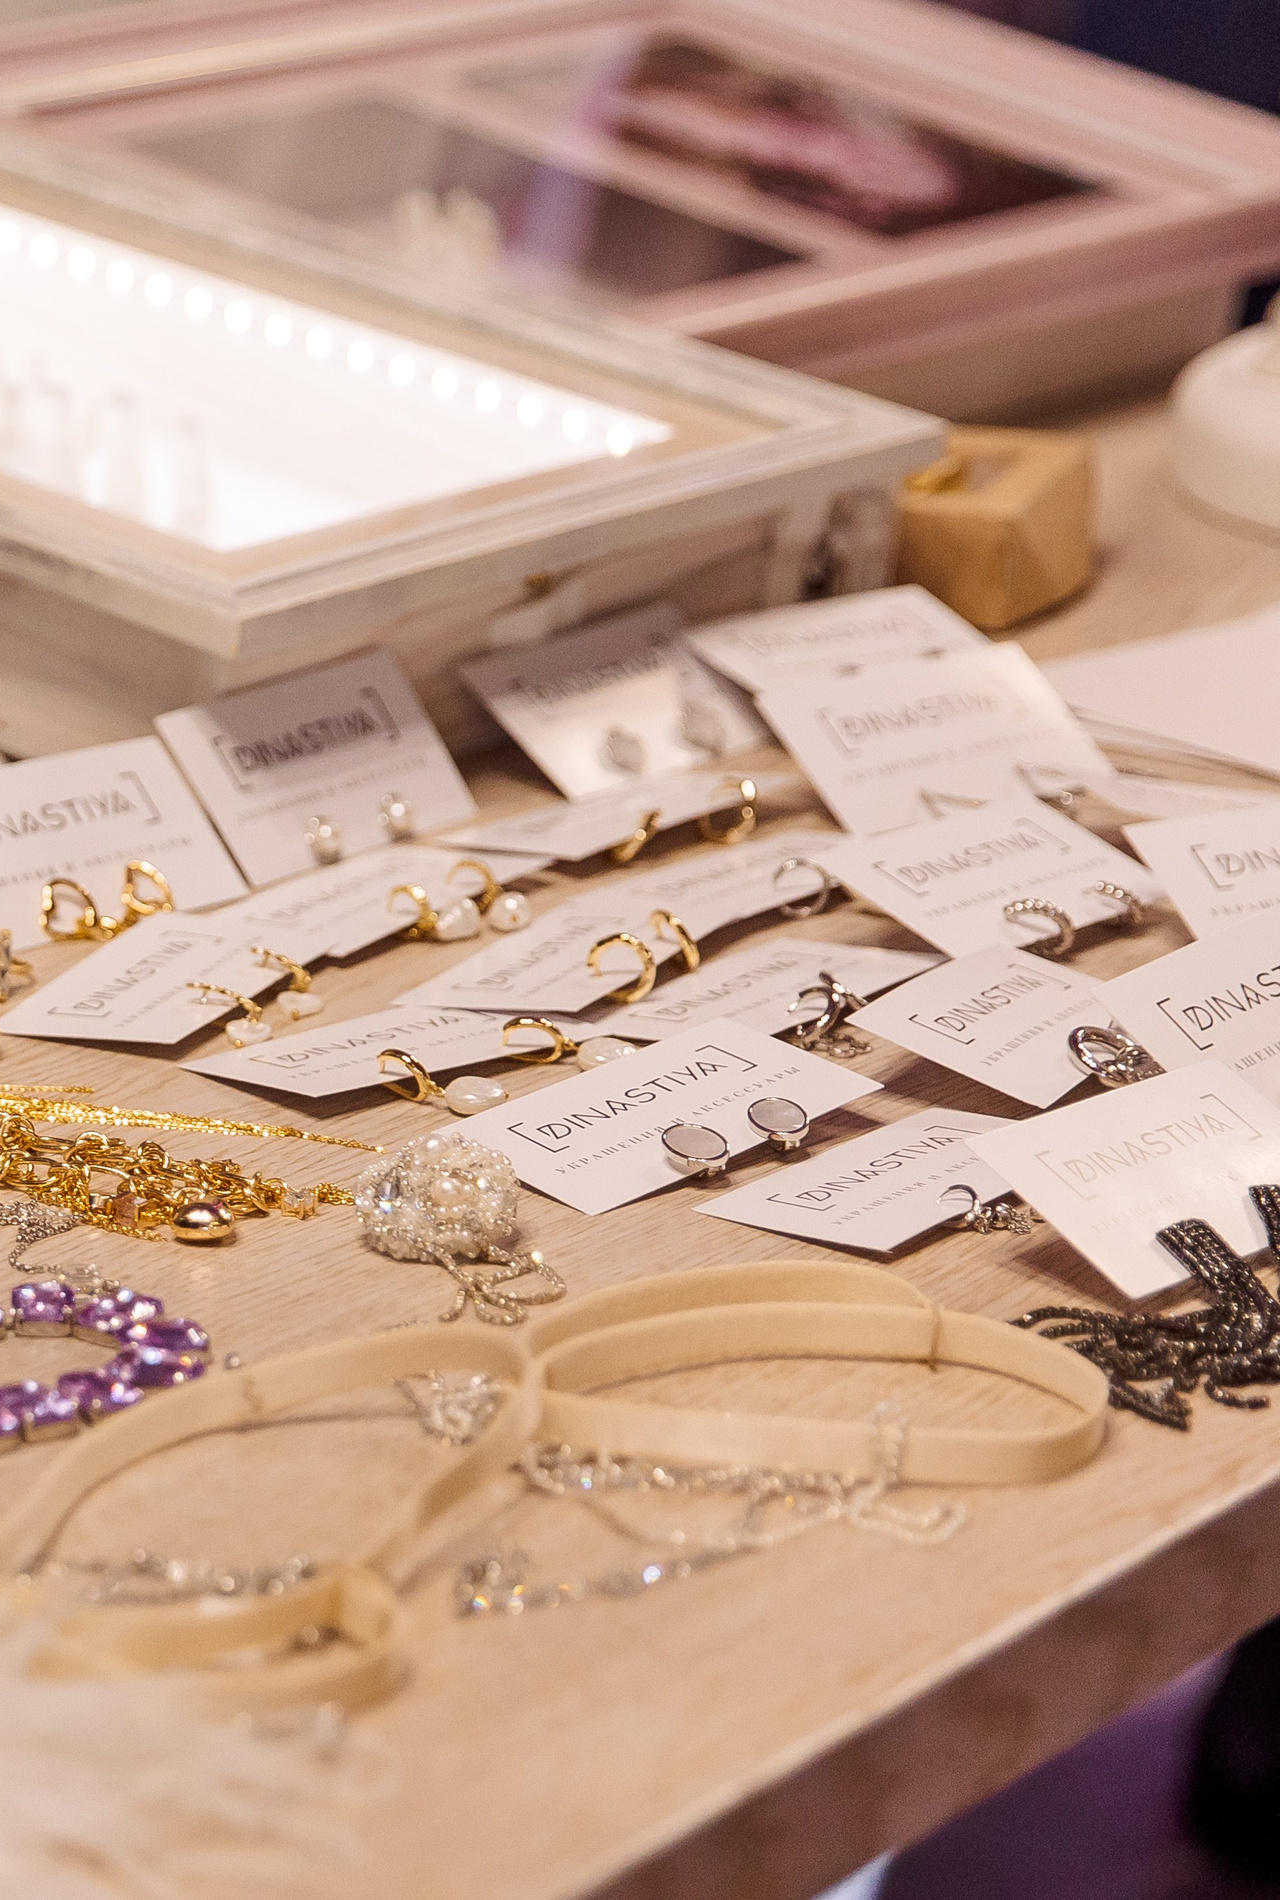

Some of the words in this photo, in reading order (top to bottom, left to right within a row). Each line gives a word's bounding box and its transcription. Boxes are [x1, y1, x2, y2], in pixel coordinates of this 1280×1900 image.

[897, 831, 1045, 886] DINASTIYA
[72, 940, 193, 1010] DINASTIYA
[933, 974, 1048, 1032] DINASTIYA
[1182, 966, 1280, 1031] DINAS
[276, 1014, 469, 1063] DINASTIYA
[536, 1060, 728, 1140] DINASTIYA
[554, 1125, 666, 1175] УКРАШЕНИЯ
[691, 1065, 802, 1118] АКСЕССУАРЫ
[795, 1136, 963, 1202] DINASTIYA
[1063, 1113, 1235, 1184] DINASTIYA
